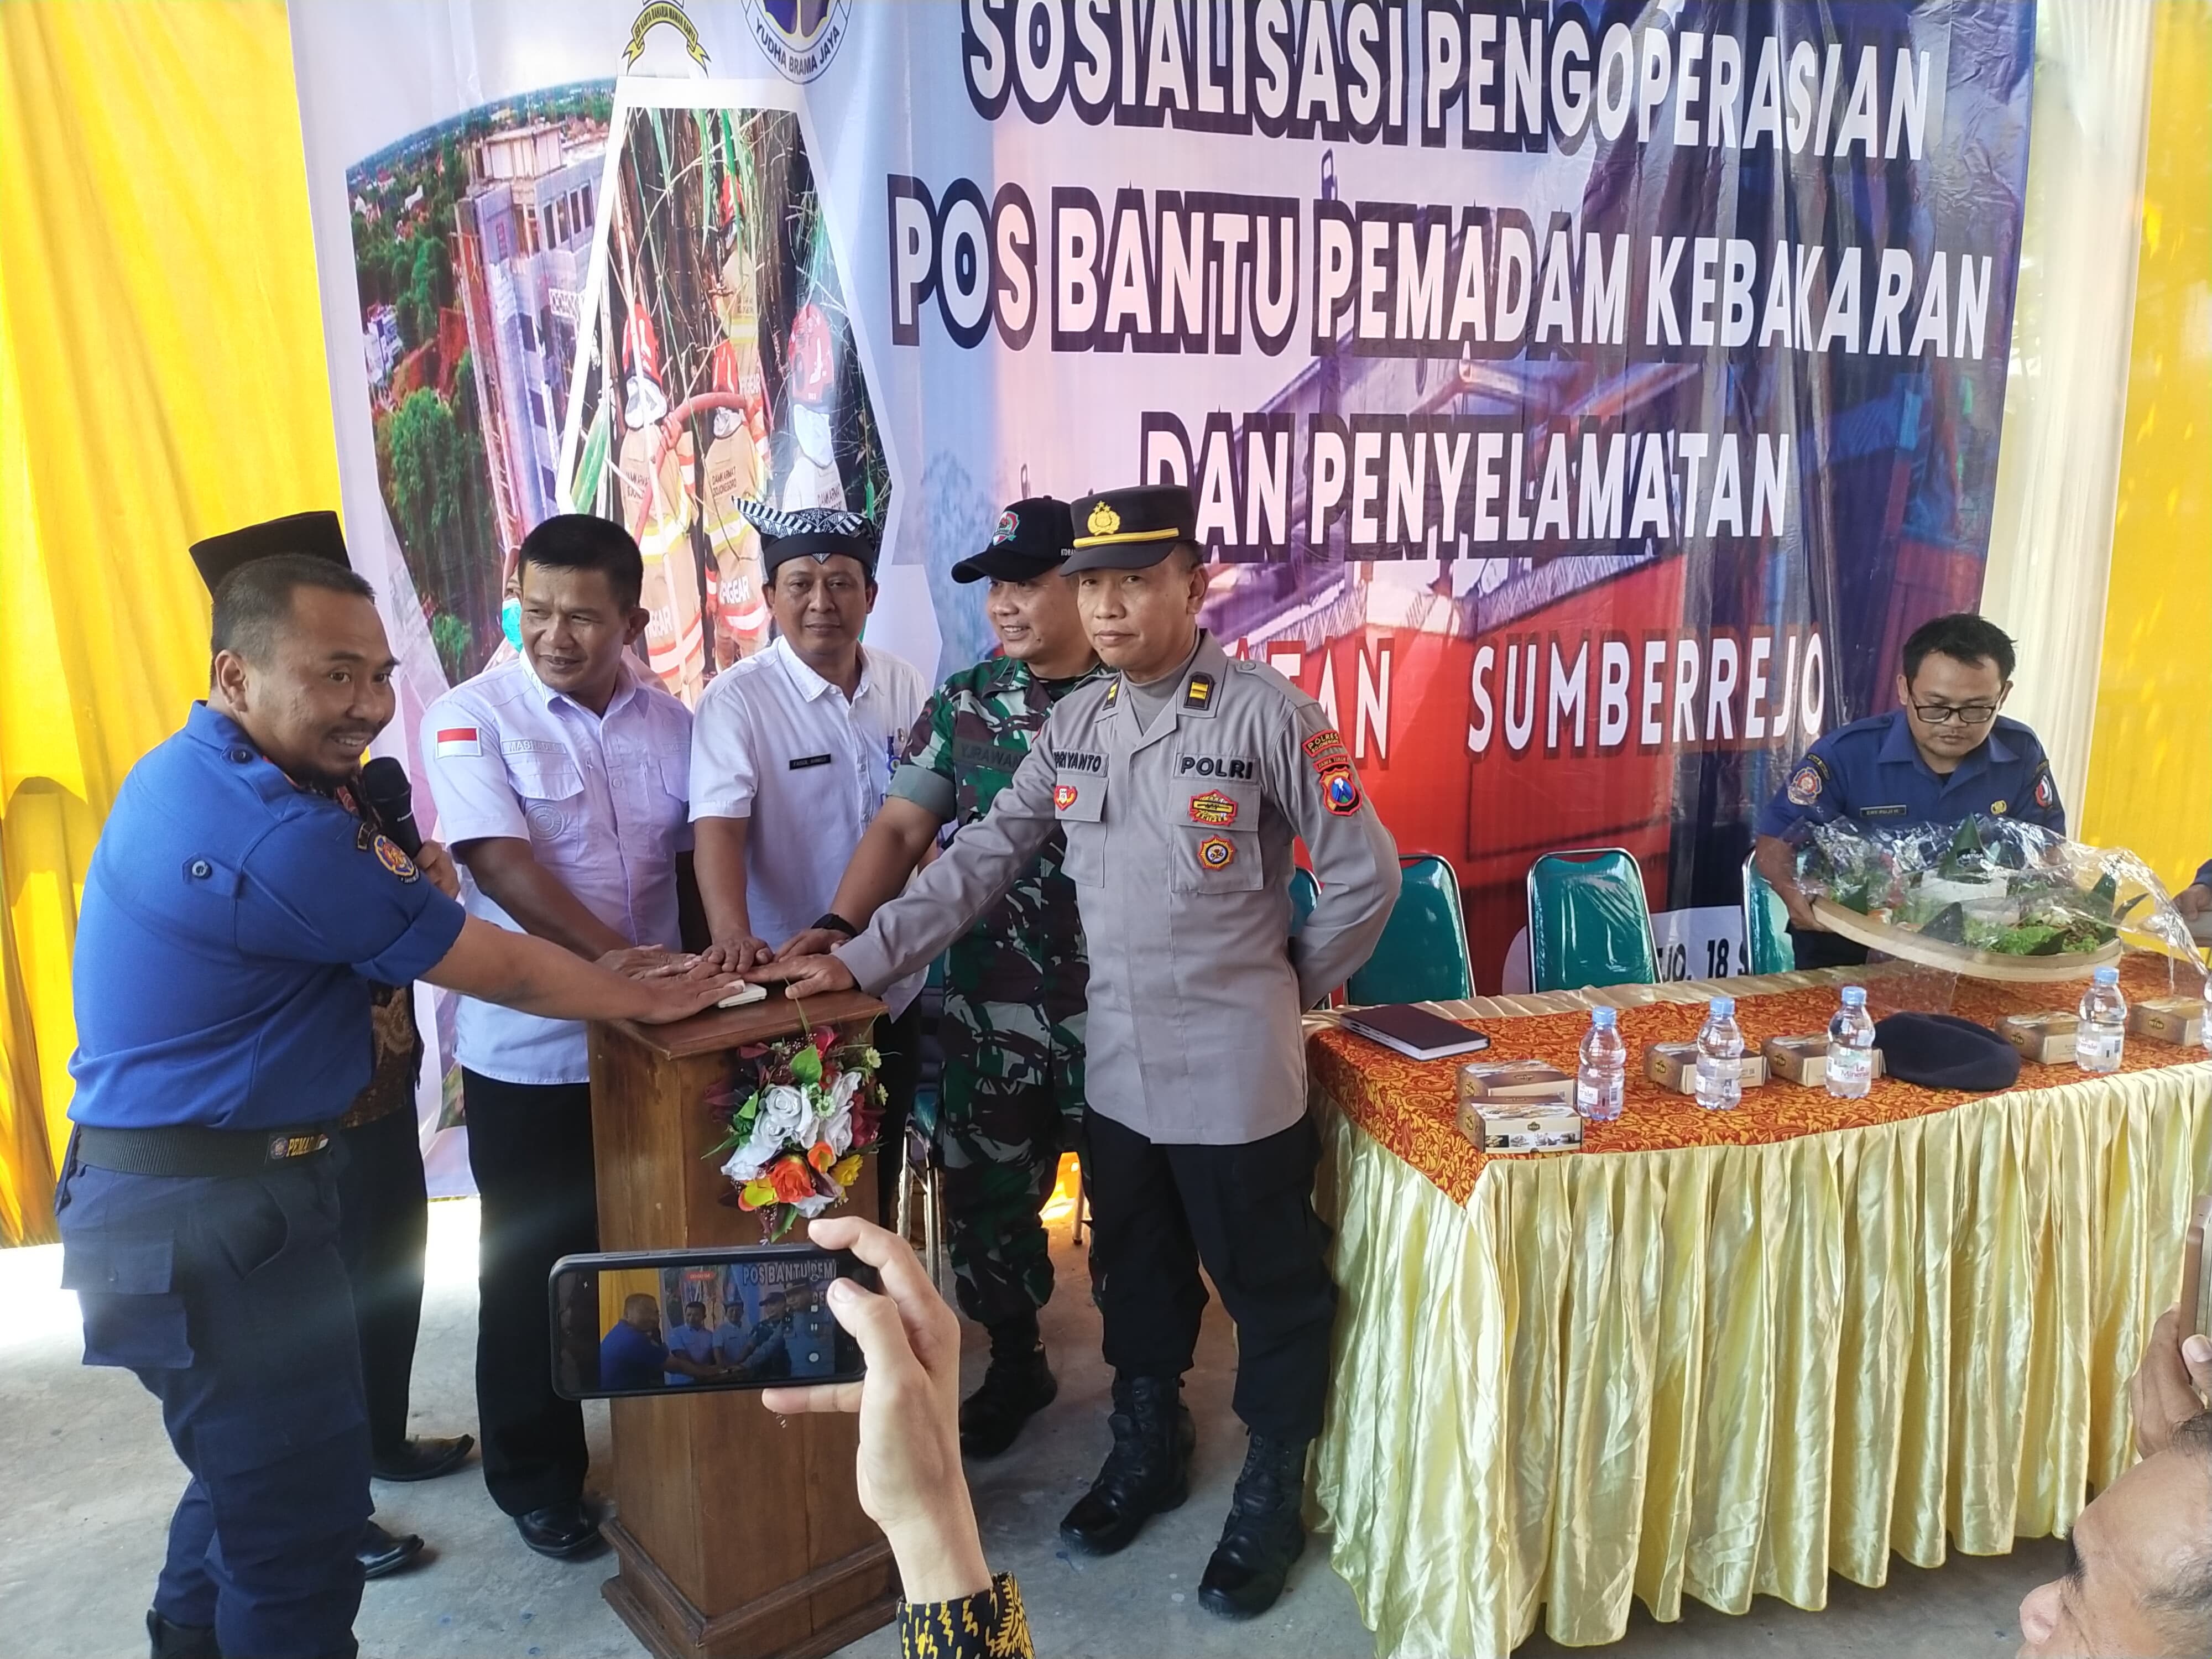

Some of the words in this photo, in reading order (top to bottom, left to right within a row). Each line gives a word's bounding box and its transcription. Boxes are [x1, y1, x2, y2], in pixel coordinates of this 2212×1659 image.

[757, 17, 786, 69] YUDHA
[789, 54, 818, 76] BRAMA
[820, 24, 840, 65] JAYA
[967, 0, 1404, 129] SOSIALISASI
[1426, 9, 1931, 161] PENGOPERASIAN
[891, 191, 1033, 336] POS
[1055, 204, 1295, 338] BANTU
[1317, 217, 1631, 346] PEMADAM
[1645, 235, 1993, 361] KEBAKARAN
[1144, 427, 1291, 546] DAN
[1310, 431, 1791, 546] PENYELAMATAN
[1061, 548, 1076, 556] KORA
[1465, 630, 1826, 754] SUMBERREJO
[1307, 732, 1339, 750] POLRES
[1180, 756, 1253, 780] POLRI
[1707, 938, 1729, 979] 18
[743, 1265, 765, 1285] POS
[768, 1262, 808, 1282] BANTU
